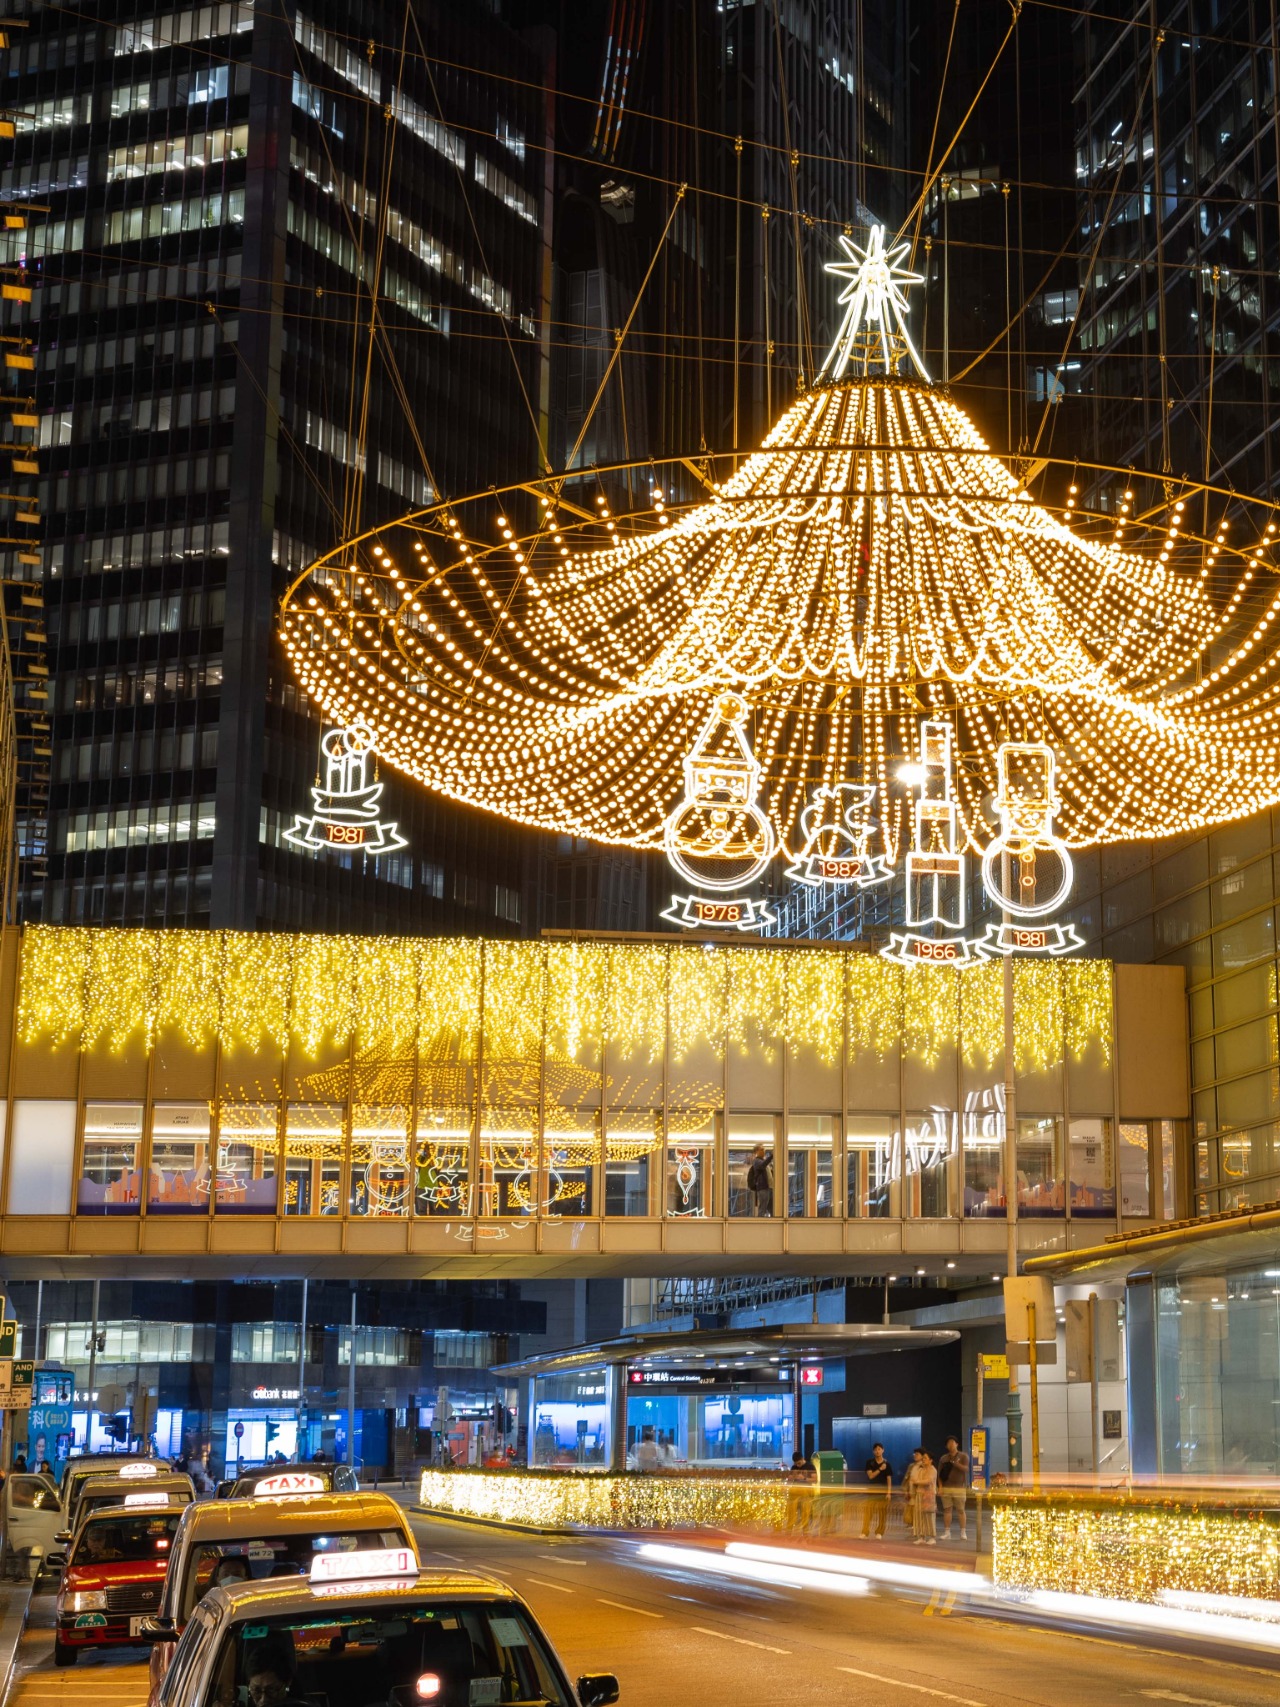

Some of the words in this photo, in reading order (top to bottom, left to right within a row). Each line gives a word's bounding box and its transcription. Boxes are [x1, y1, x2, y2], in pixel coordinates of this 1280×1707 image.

[327, 825, 364, 844] 1981
[818, 861, 862, 877] 1982
[695, 904, 740, 921] 1978
[1014, 931, 1046, 947] 1981
[914, 942, 956, 960] 1966
[781, 1371, 787, 1379] E
[265, 1477, 314, 1491] TAXI
[321, 1552, 408, 1577] TAXI
